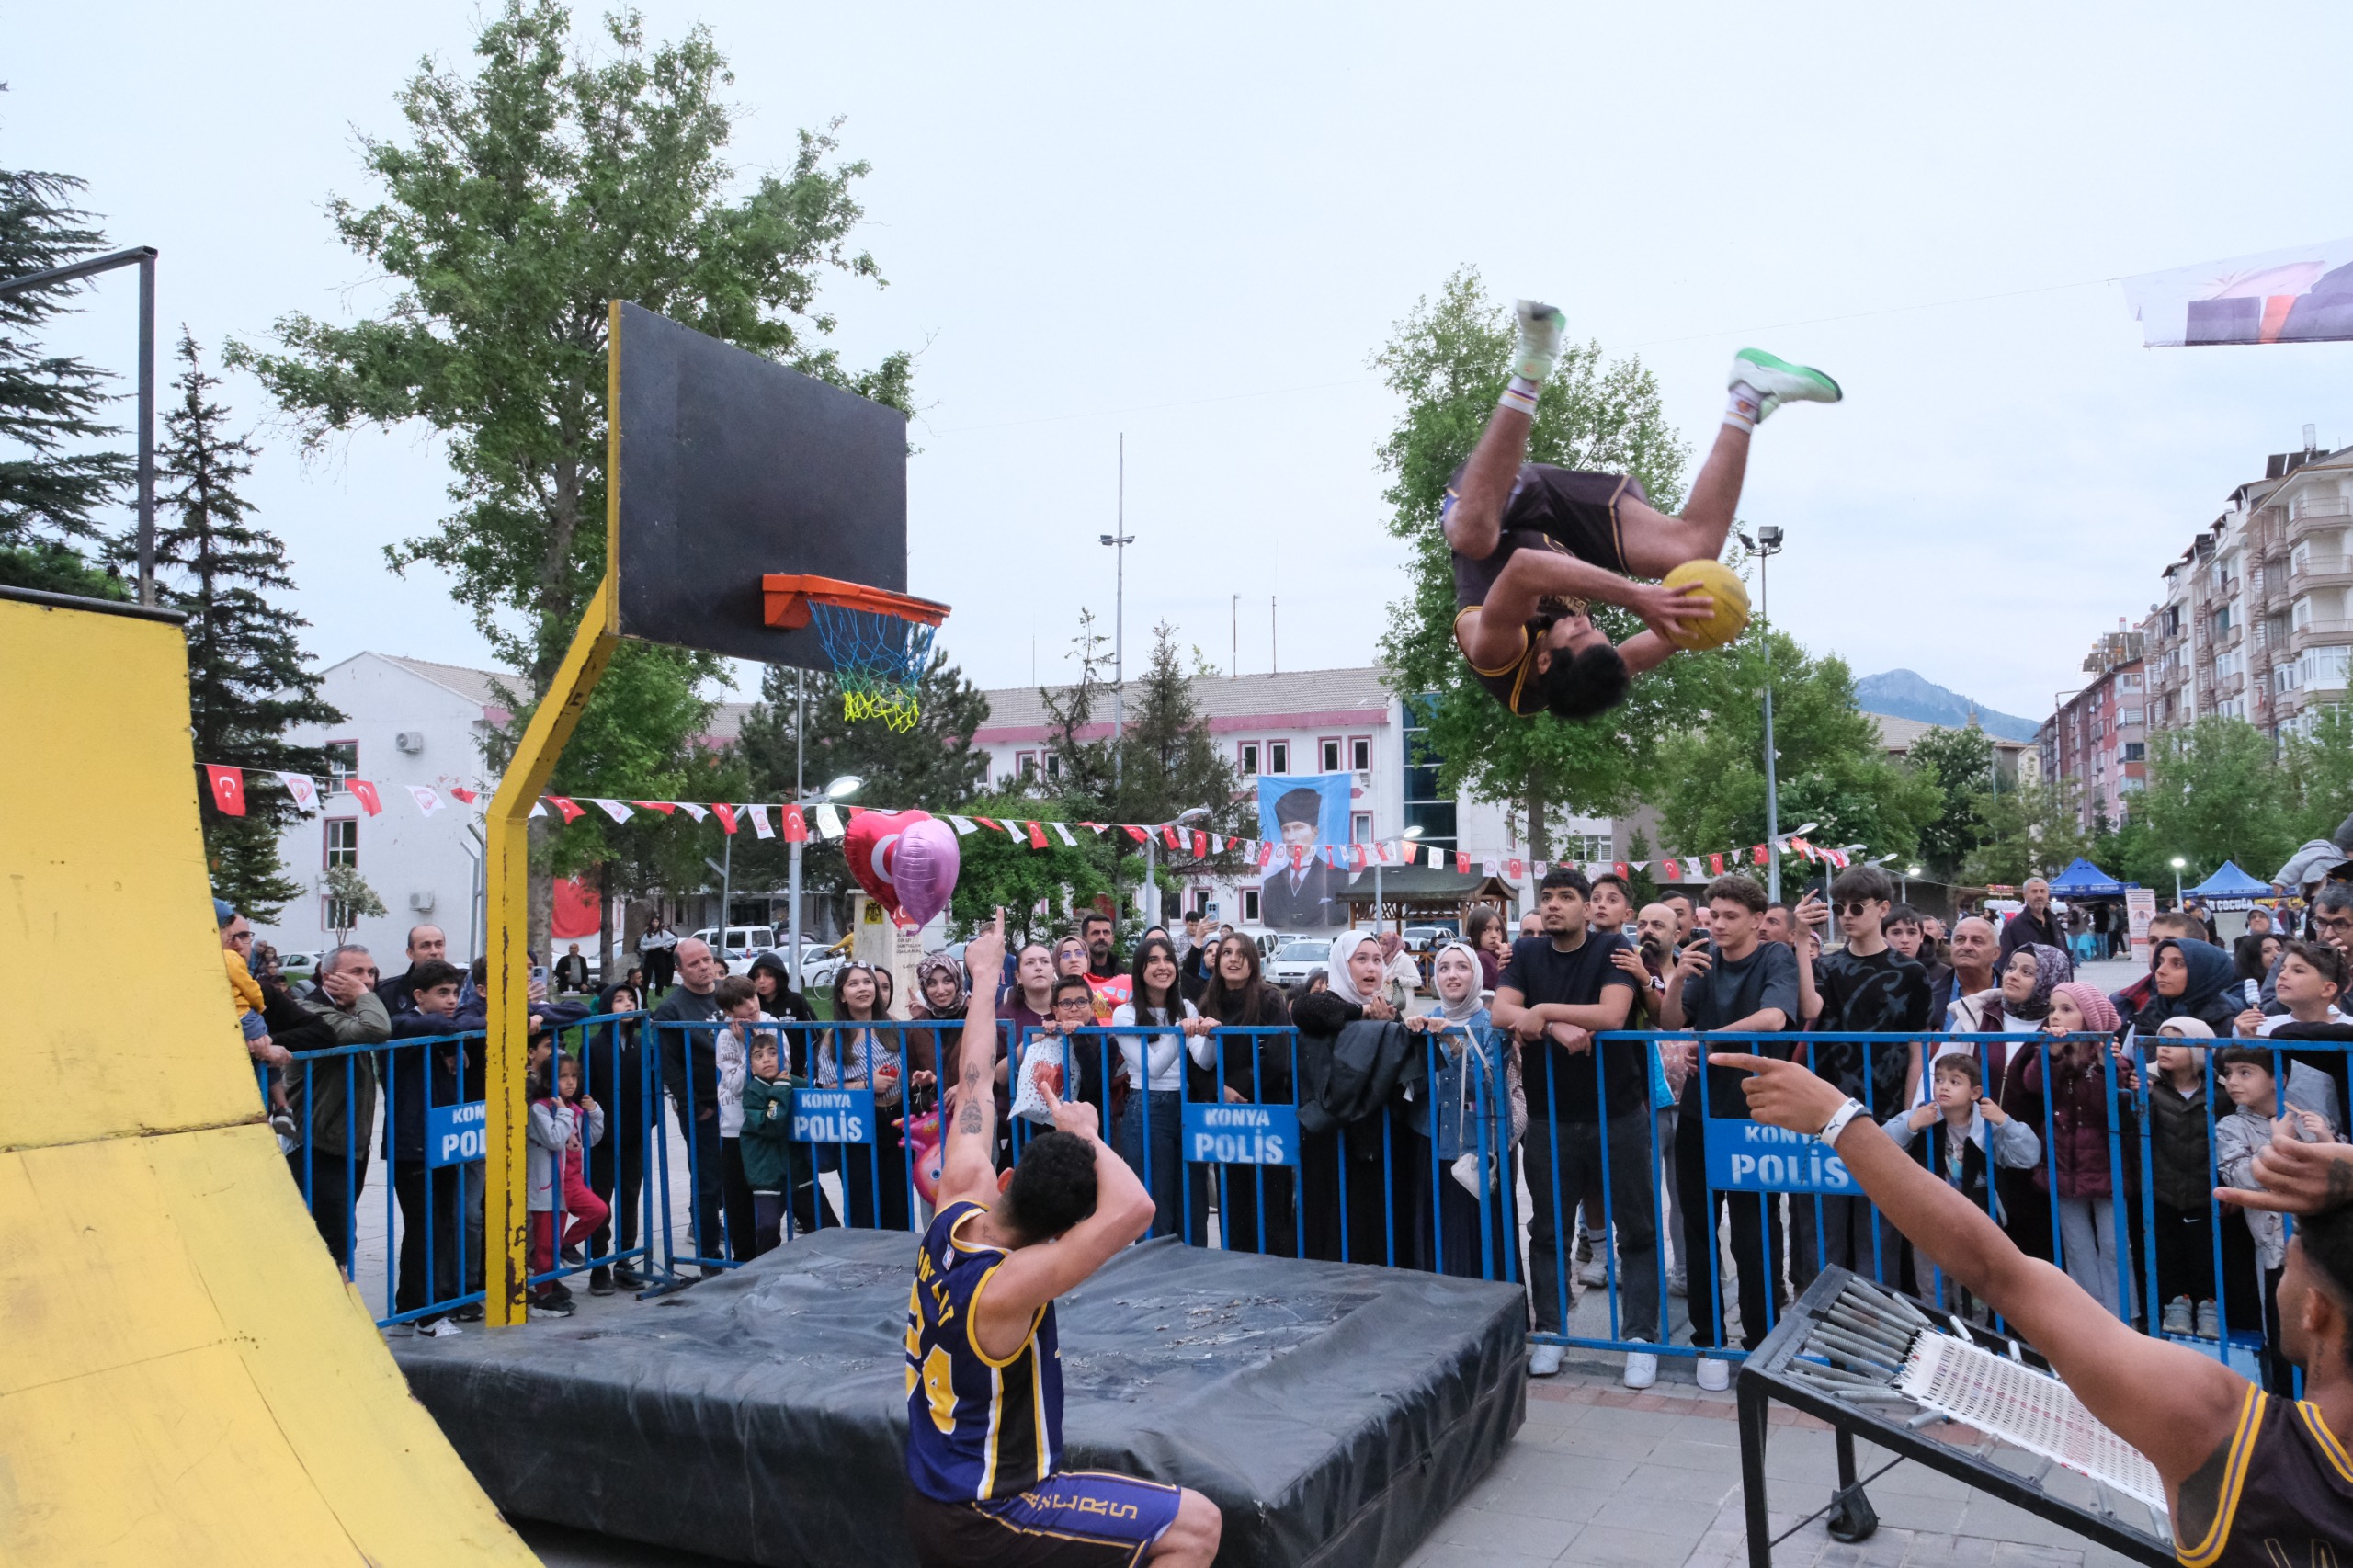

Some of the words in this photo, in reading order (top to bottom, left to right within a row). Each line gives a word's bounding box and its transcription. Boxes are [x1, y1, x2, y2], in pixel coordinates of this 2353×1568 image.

[801, 1093, 853, 1108] KONYA
[452, 1104, 486, 1124] KON
[793, 1109, 863, 1142] POLİS
[1205, 1108, 1270, 1127] KONYA
[442, 1128, 486, 1162] POL
[1195, 1128, 1284, 1164] POLİS
[1745, 1125, 1819, 1145] KONY
[1731, 1149, 1849, 1189] POLİS
